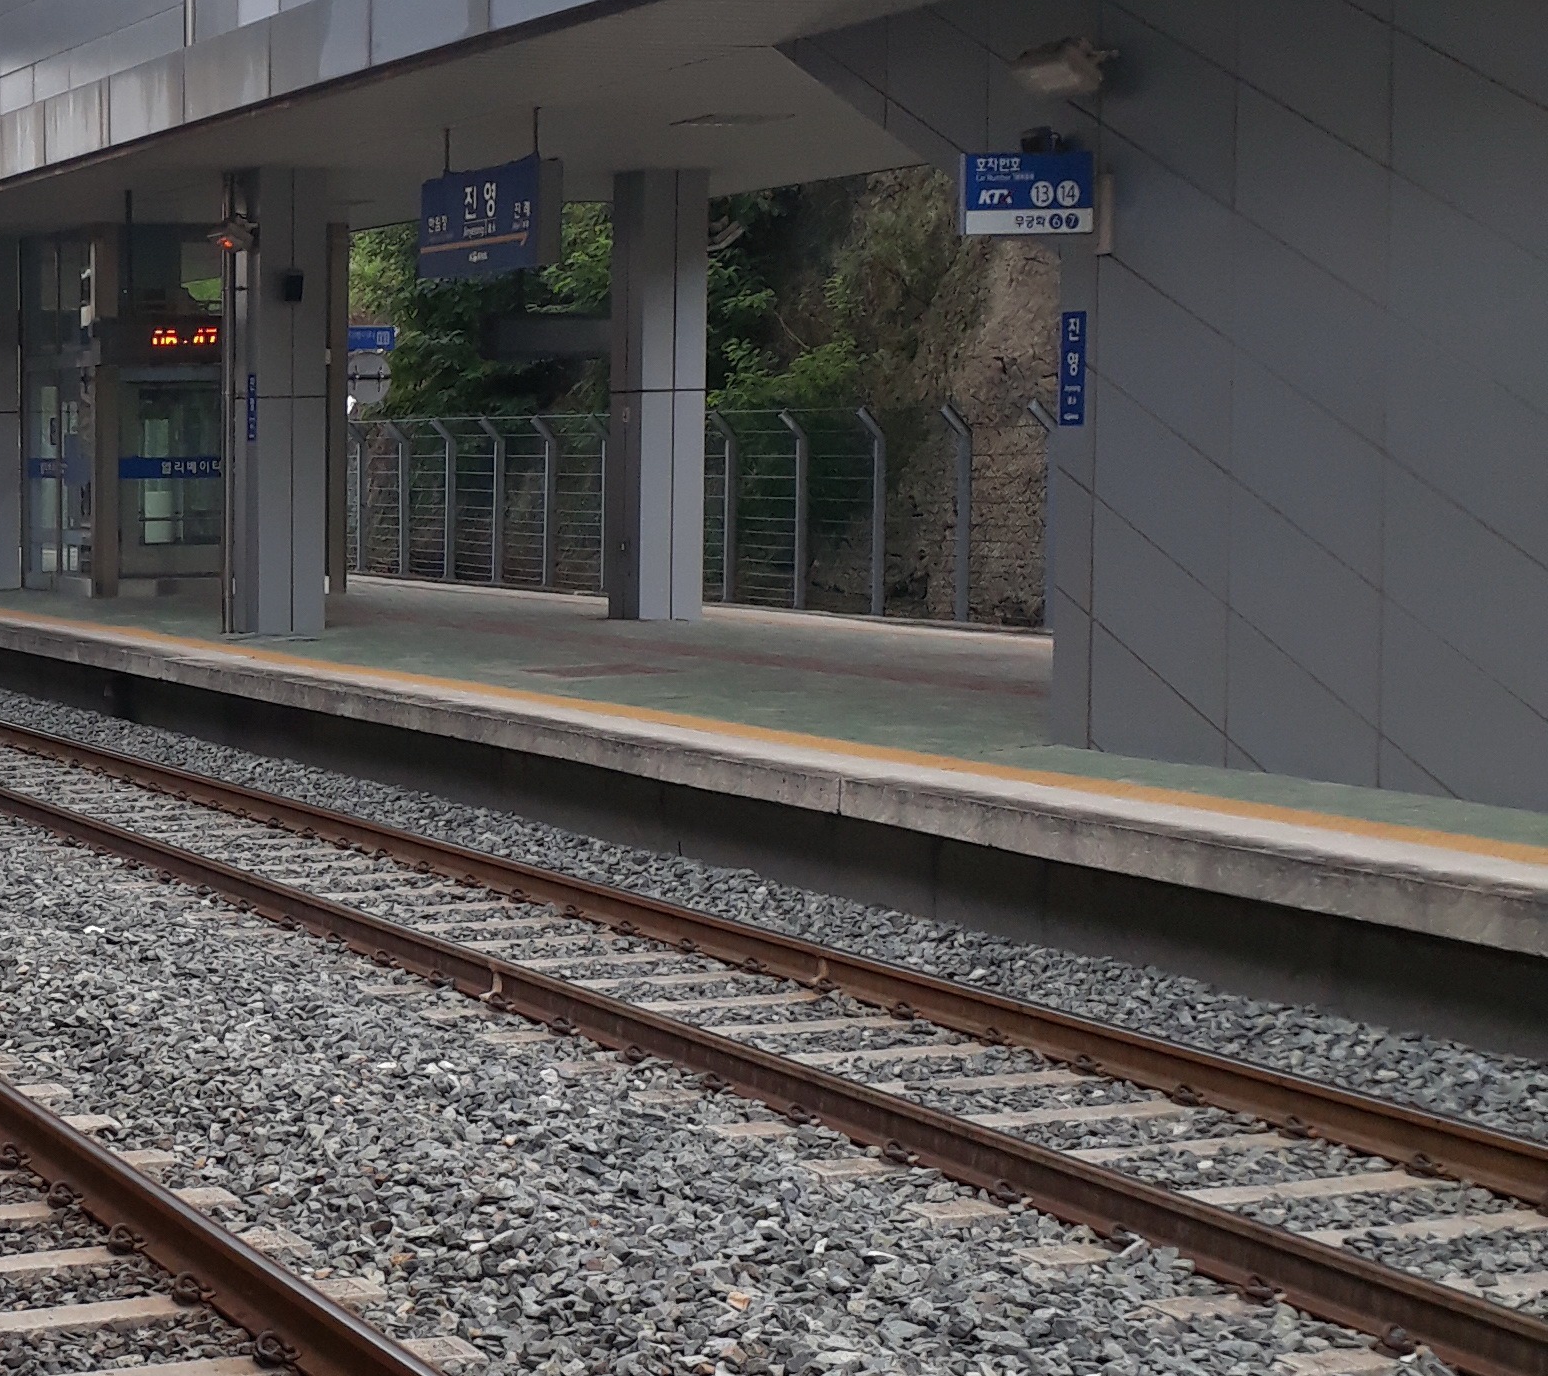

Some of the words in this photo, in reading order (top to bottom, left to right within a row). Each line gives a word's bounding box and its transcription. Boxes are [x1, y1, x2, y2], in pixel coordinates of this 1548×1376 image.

[464, 182, 497, 220] 진영
[978, 188, 1014, 205] KTX
[1033, 183, 1052, 204] 13
[1058, 182, 1078, 203] 14
[1015, 215, 1047, 229] 무궁화
